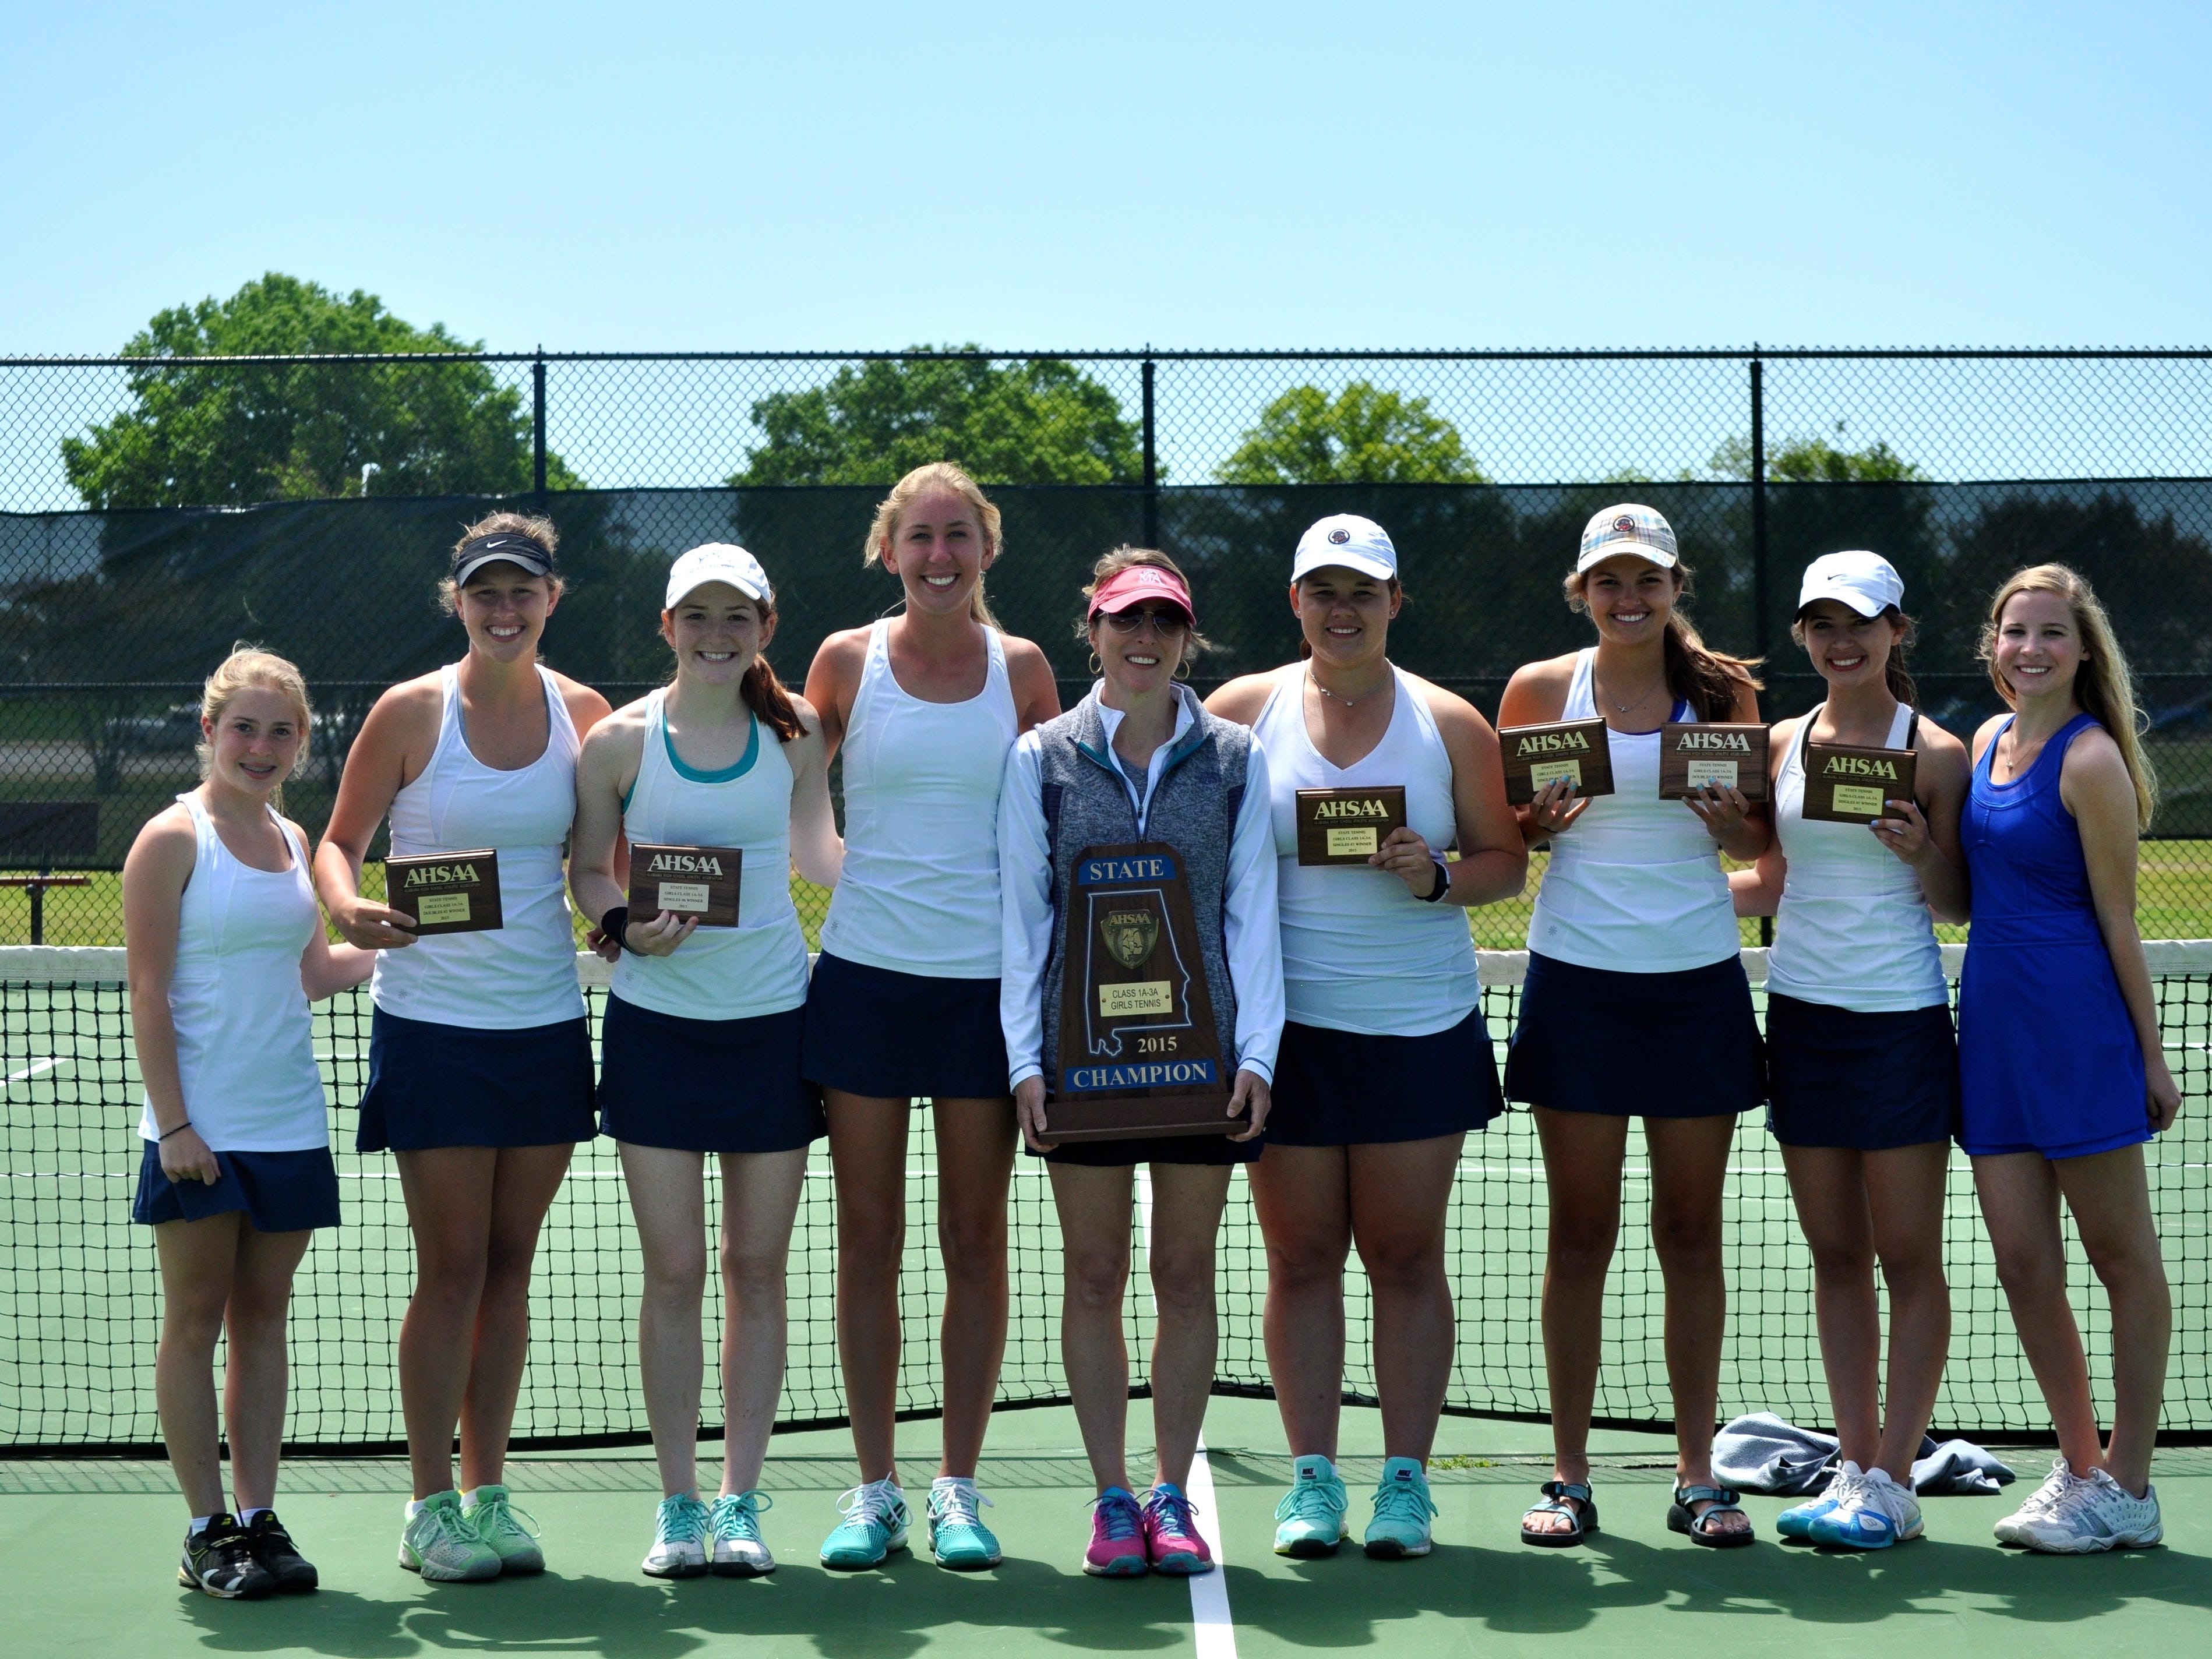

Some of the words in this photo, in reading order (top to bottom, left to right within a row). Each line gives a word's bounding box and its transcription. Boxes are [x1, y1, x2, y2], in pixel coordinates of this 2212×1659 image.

[1516, 730, 1590, 757] AHSAA
[1675, 732, 1751, 751] AHSAA
[1822, 756, 1898, 780] AHSAA
[1313, 799, 1389, 820] AHSAA
[647, 853, 724, 876] AHSAA
[1090, 859, 1164, 881] STATE
[403, 863, 481, 888] AHSAA
[1109, 913, 1151, 926] AHSAA
[1112, 989, 1136, 998] CLASS
[1138, 988, 1158, 997] 1A-3A
[1111, 1000, 1133, 1009] GIRLS
[1134, 999, 1161, 1008] TENNIS
[1137, 1036, 1177, 1053] 2015
[1073, 1063, 1207, 1088] CHAMPION
